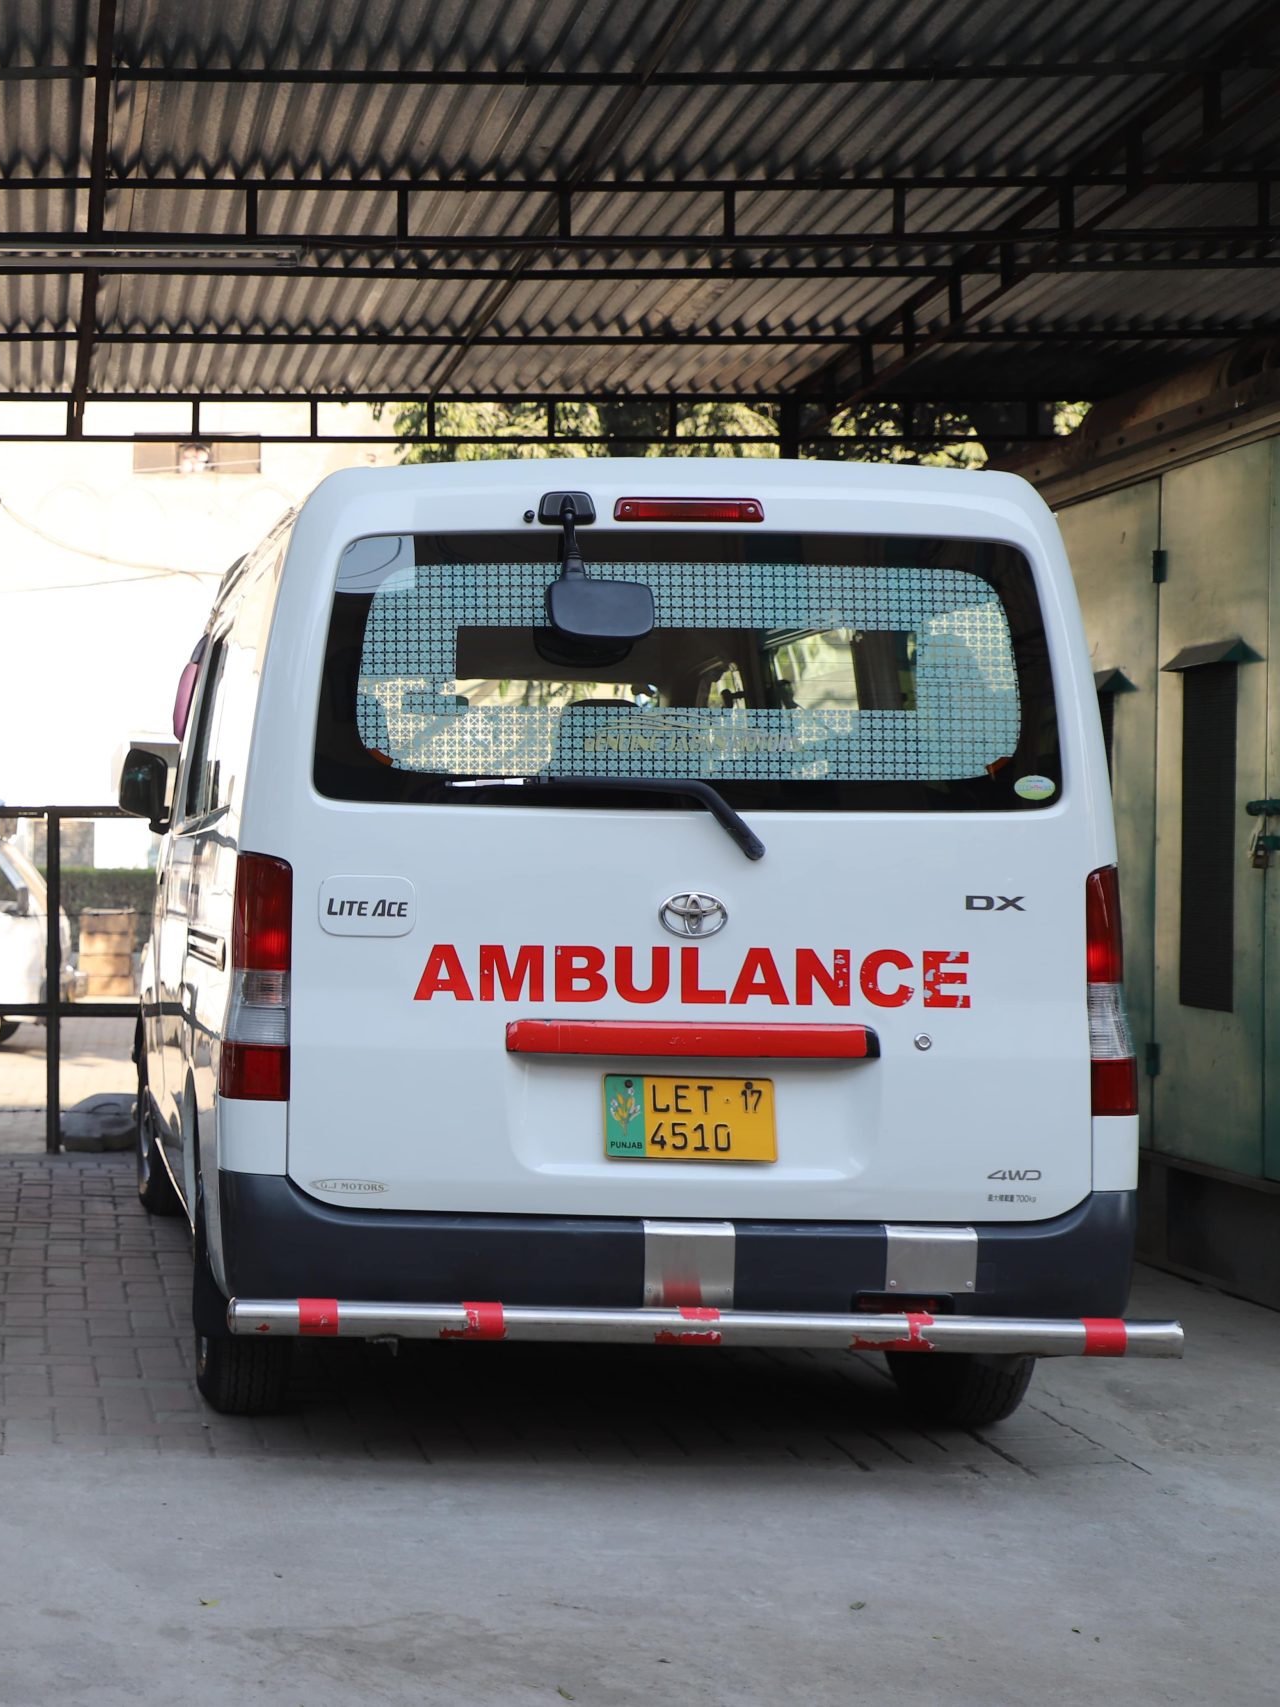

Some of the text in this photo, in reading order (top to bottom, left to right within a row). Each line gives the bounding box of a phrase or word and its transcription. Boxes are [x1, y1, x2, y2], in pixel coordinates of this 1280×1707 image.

[327, 898, 408, 917] LITE ACE
[965, 895, 1027, 911] DX
[414, 944, 972, 1008] AMBULANCE
[652, 1084, 762, 1113] LET 17
[650, 1122, 731, 1151] 4510
[610, 1141, 643, 1150] PUNJAB
[987, 1169, 1041, 1181] 4WD
[341, 1183, 385, 1192] MOTORS
